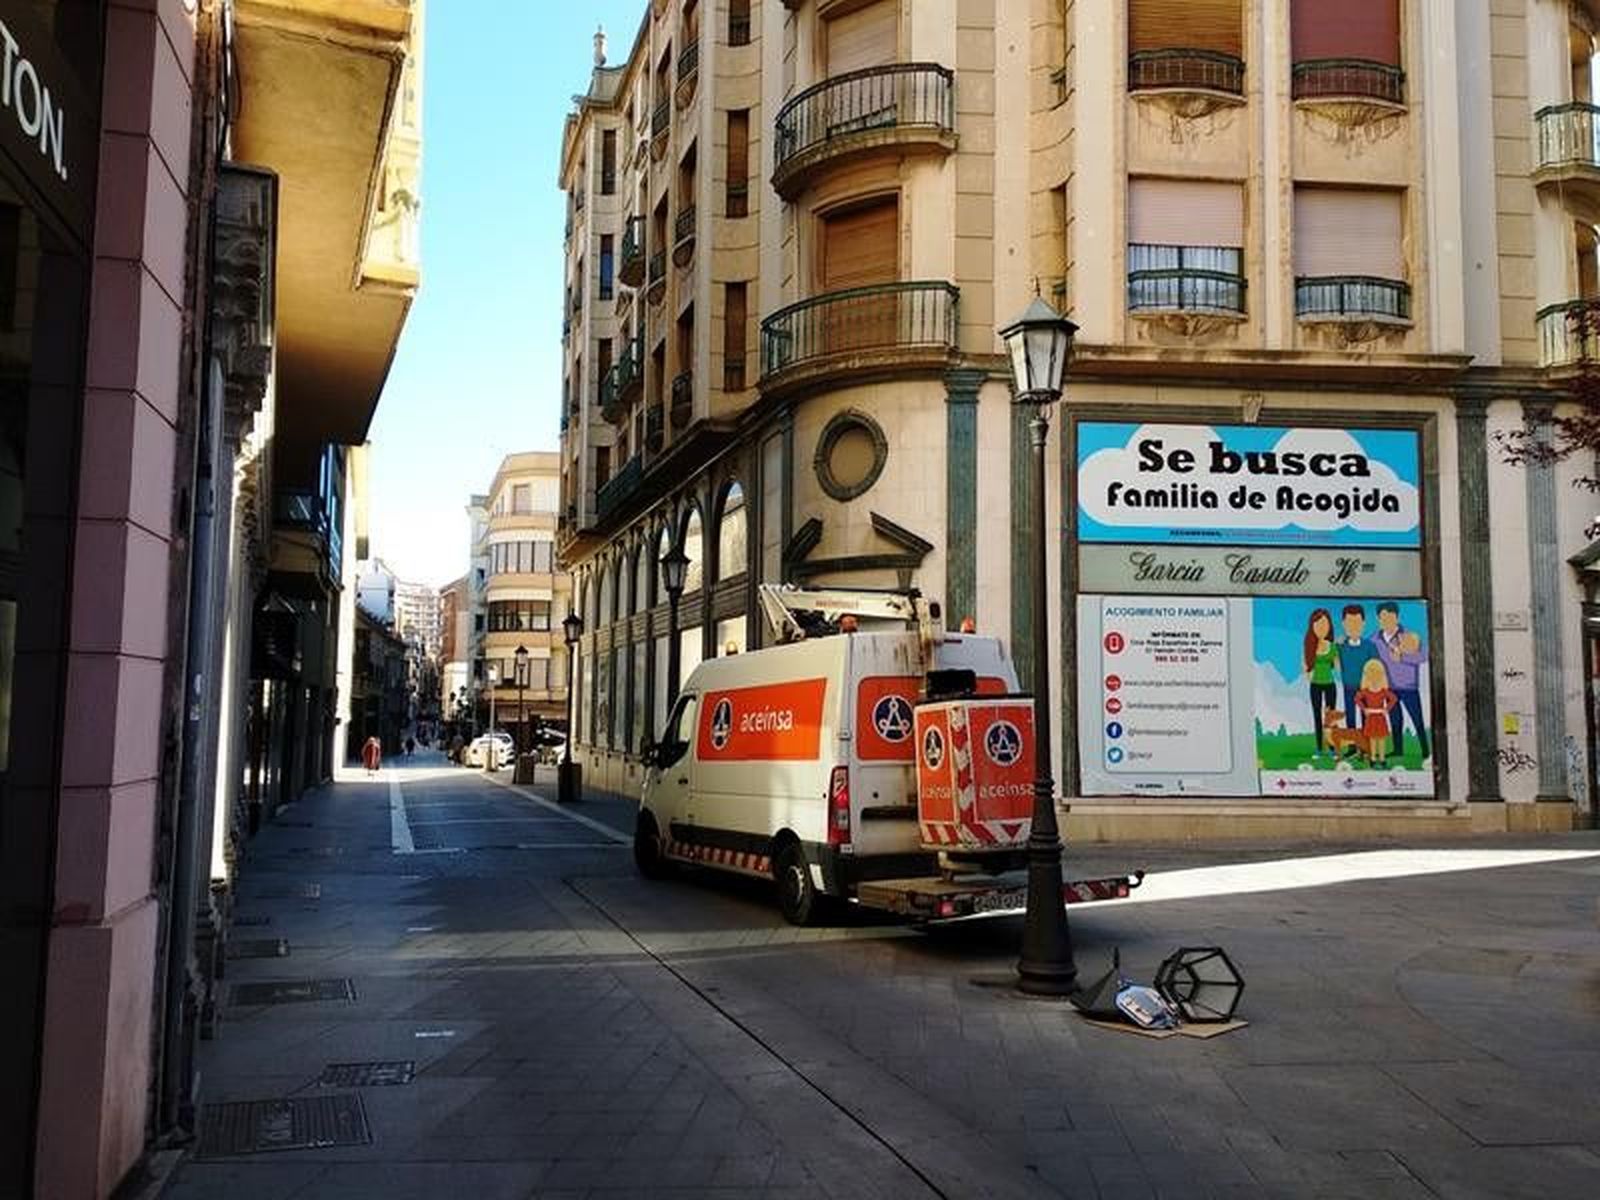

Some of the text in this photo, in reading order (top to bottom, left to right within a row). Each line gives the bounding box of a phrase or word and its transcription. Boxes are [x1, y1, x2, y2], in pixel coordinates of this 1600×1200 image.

[1138, 440, 1371, 477] Se busca
[1107, 481, 1400, 520] Familia de Acogida
[1224, 554, 1311, 585] Casado
[1105, 607, 1224, 618] ACOGIMIENTO FAMILIAR
